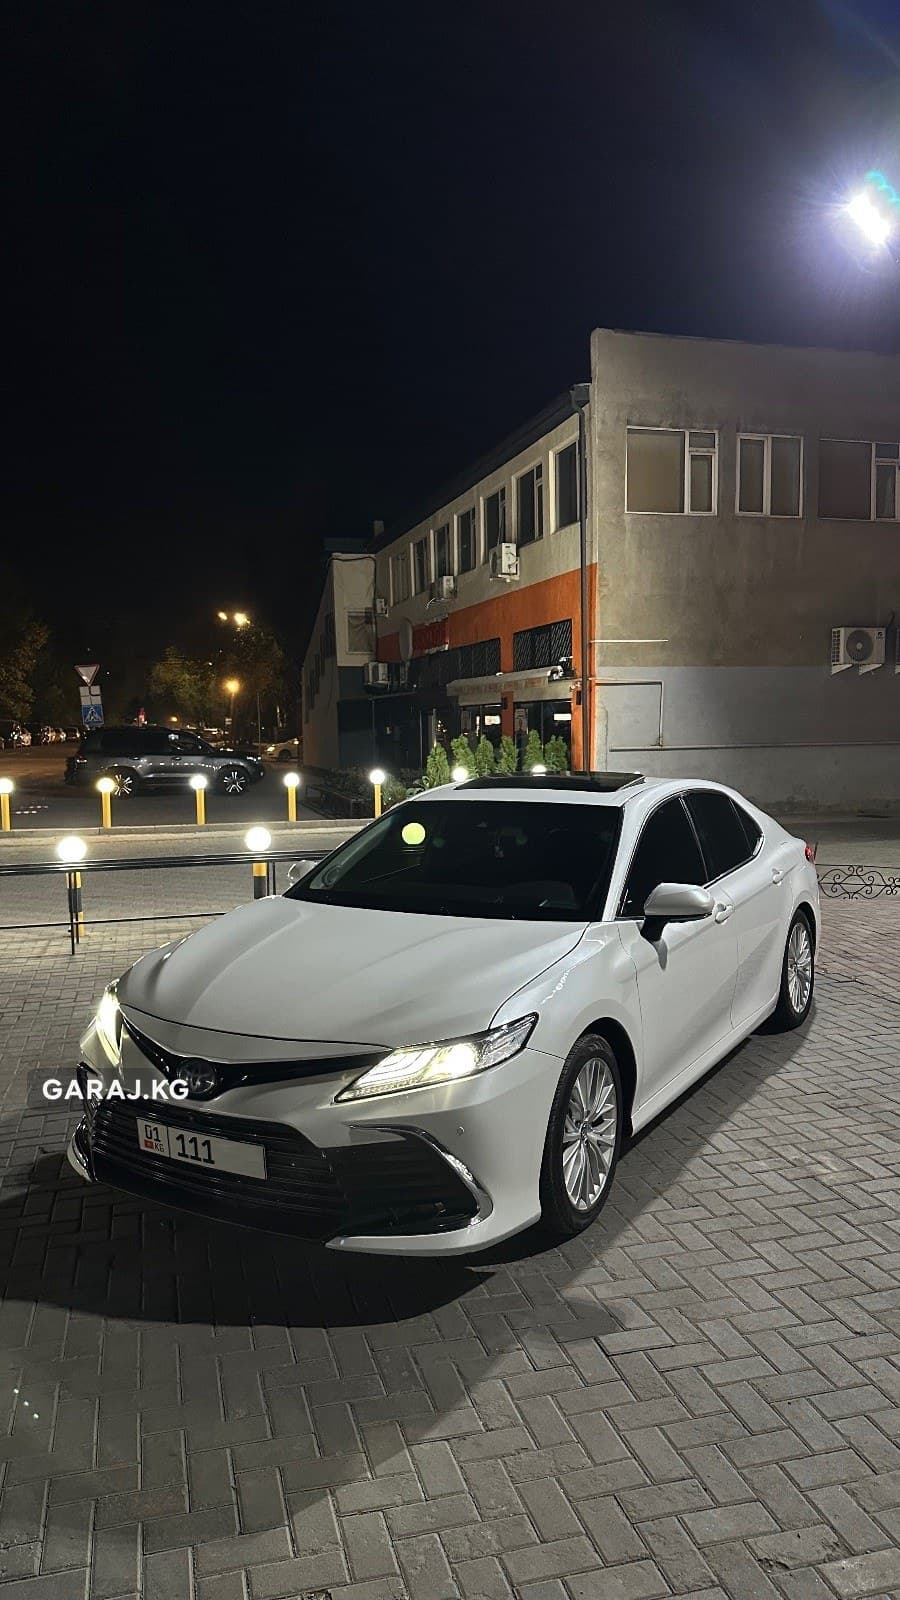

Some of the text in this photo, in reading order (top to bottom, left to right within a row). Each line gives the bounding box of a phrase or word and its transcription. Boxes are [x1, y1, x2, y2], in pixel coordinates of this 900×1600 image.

[145, 1125, 215, 1164] 01 111
[154, 1142, 165, 1153] KG
